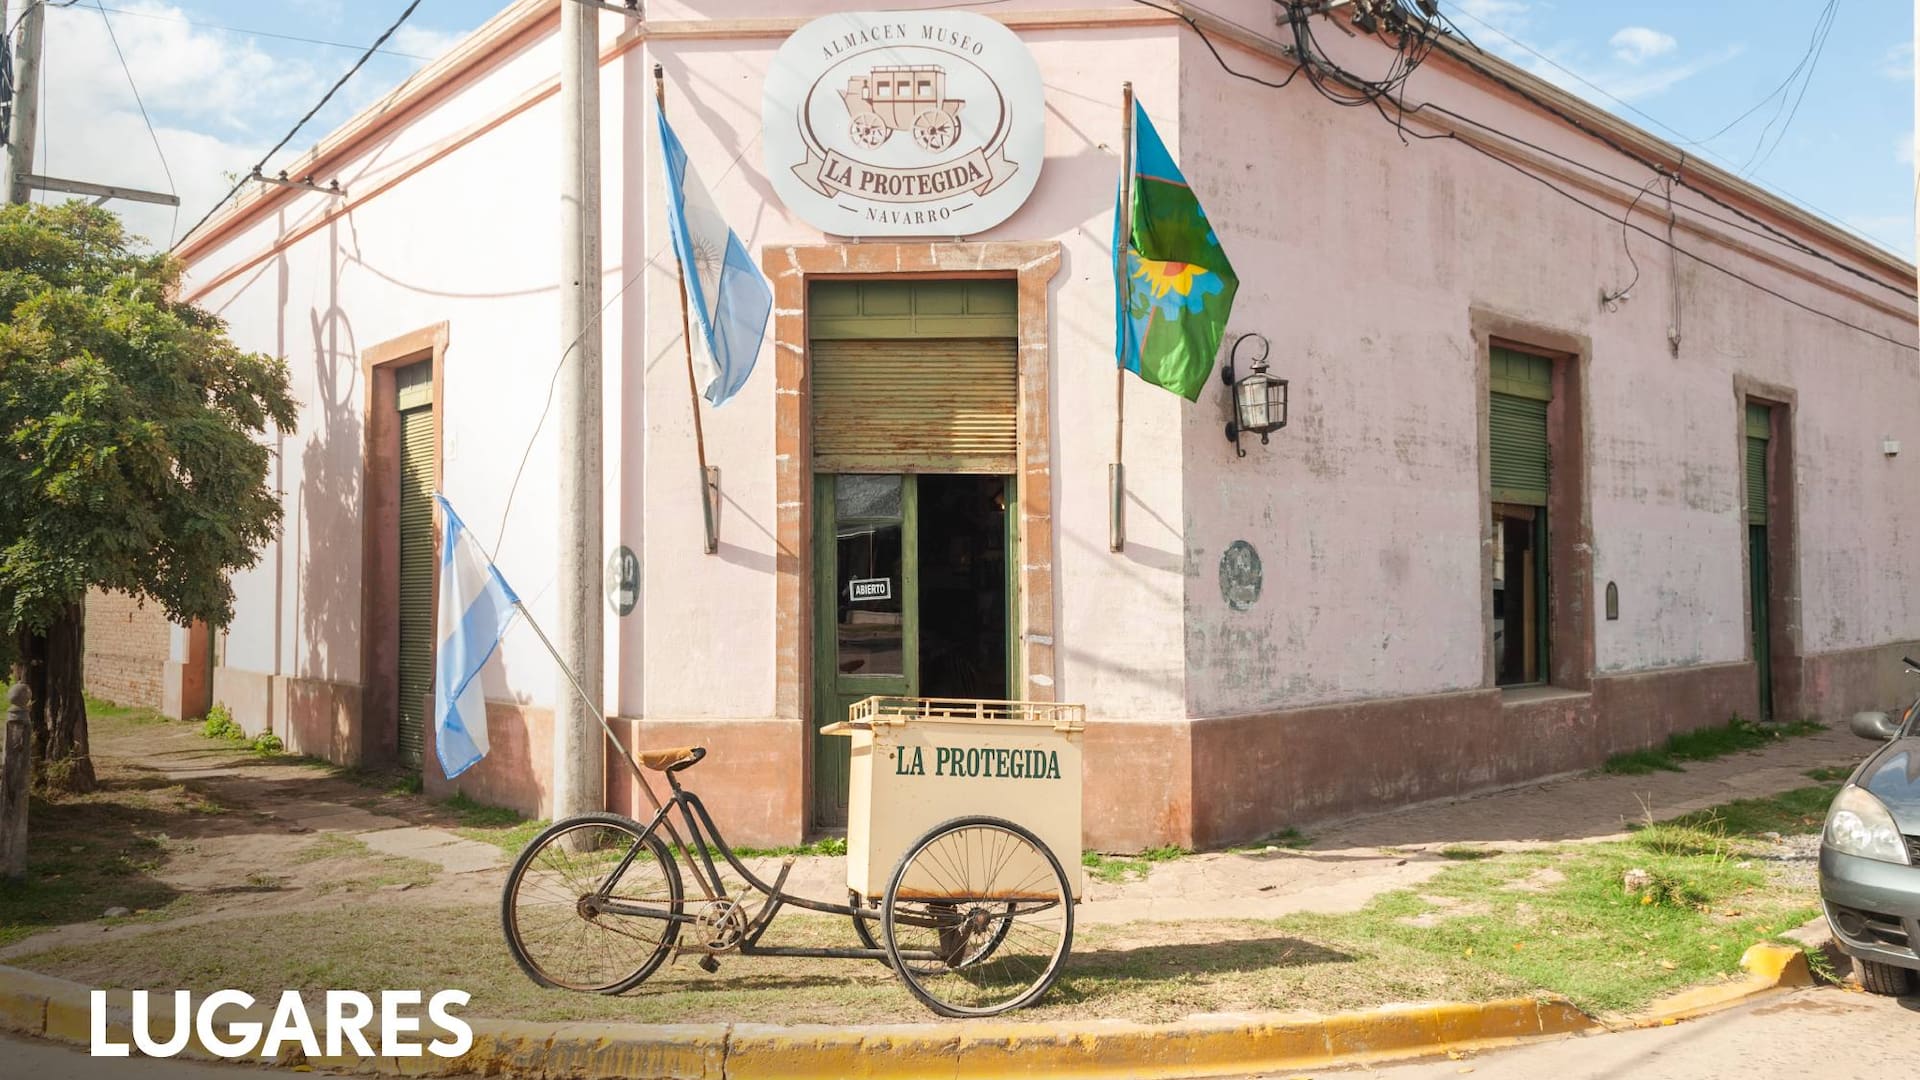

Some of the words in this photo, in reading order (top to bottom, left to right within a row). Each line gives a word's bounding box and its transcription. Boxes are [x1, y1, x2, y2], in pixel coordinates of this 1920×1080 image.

[822, 23, 906, 60] ALMACEN
[921, 25, 984, 56] MUSEO
[824, 159, 852, 188] LA
[859, 160, 984, 196] PROTEGIDA
[866, 206, 951, 225] NAVARRO
[855, 583, 886, 595] ABIERTO
[895, 745, 926, 776] LA
[935, 746, 1062, 780] PROTEGIDA
